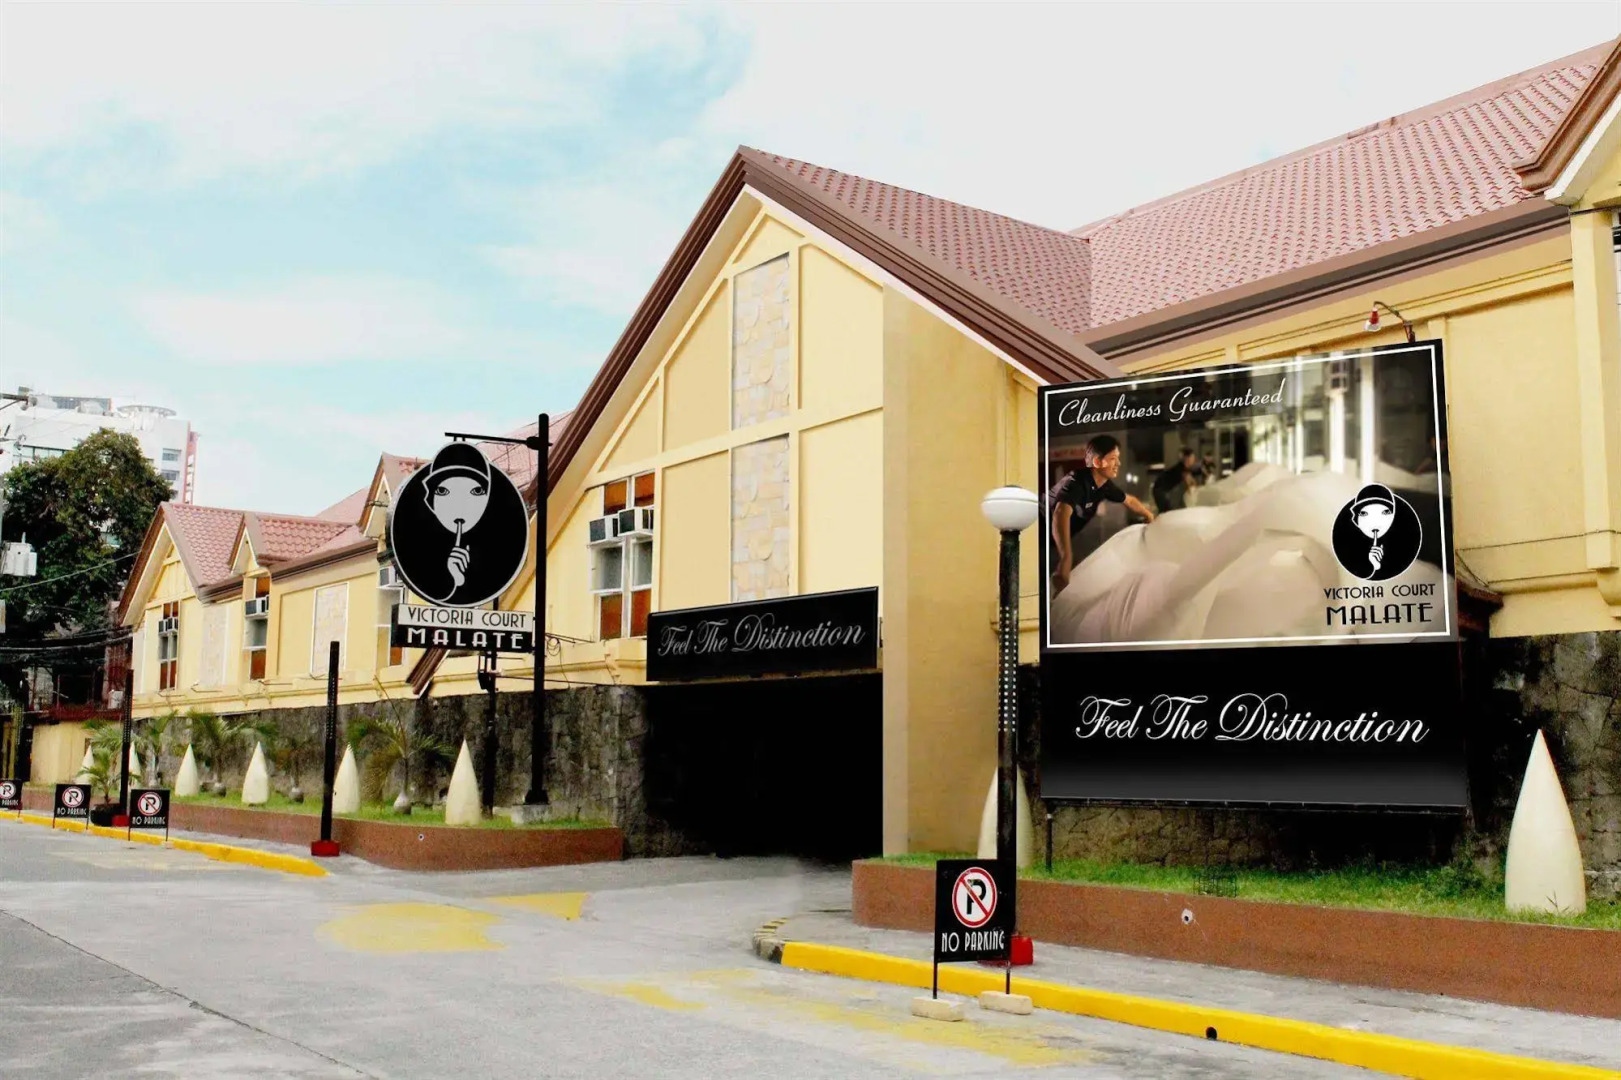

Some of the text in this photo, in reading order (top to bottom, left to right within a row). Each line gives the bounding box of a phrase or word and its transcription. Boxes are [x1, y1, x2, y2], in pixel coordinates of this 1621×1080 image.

[1058, 377, 1286, 427] Cleanliness Guaranteed
[1323, 583, 1436, 600] VICTORIA COURT
[408, 606, 526, 628] VICTORIA COURT
[1326, 602, 1433, 626] MALATE
[407, 627, 524, 649] MALATE
[657, 612, 866, 656] Feel The Distinction
[1075, 692, 1430, 743] Feel The Distinction
[941, 930, 1006, 953] NO PARKING
